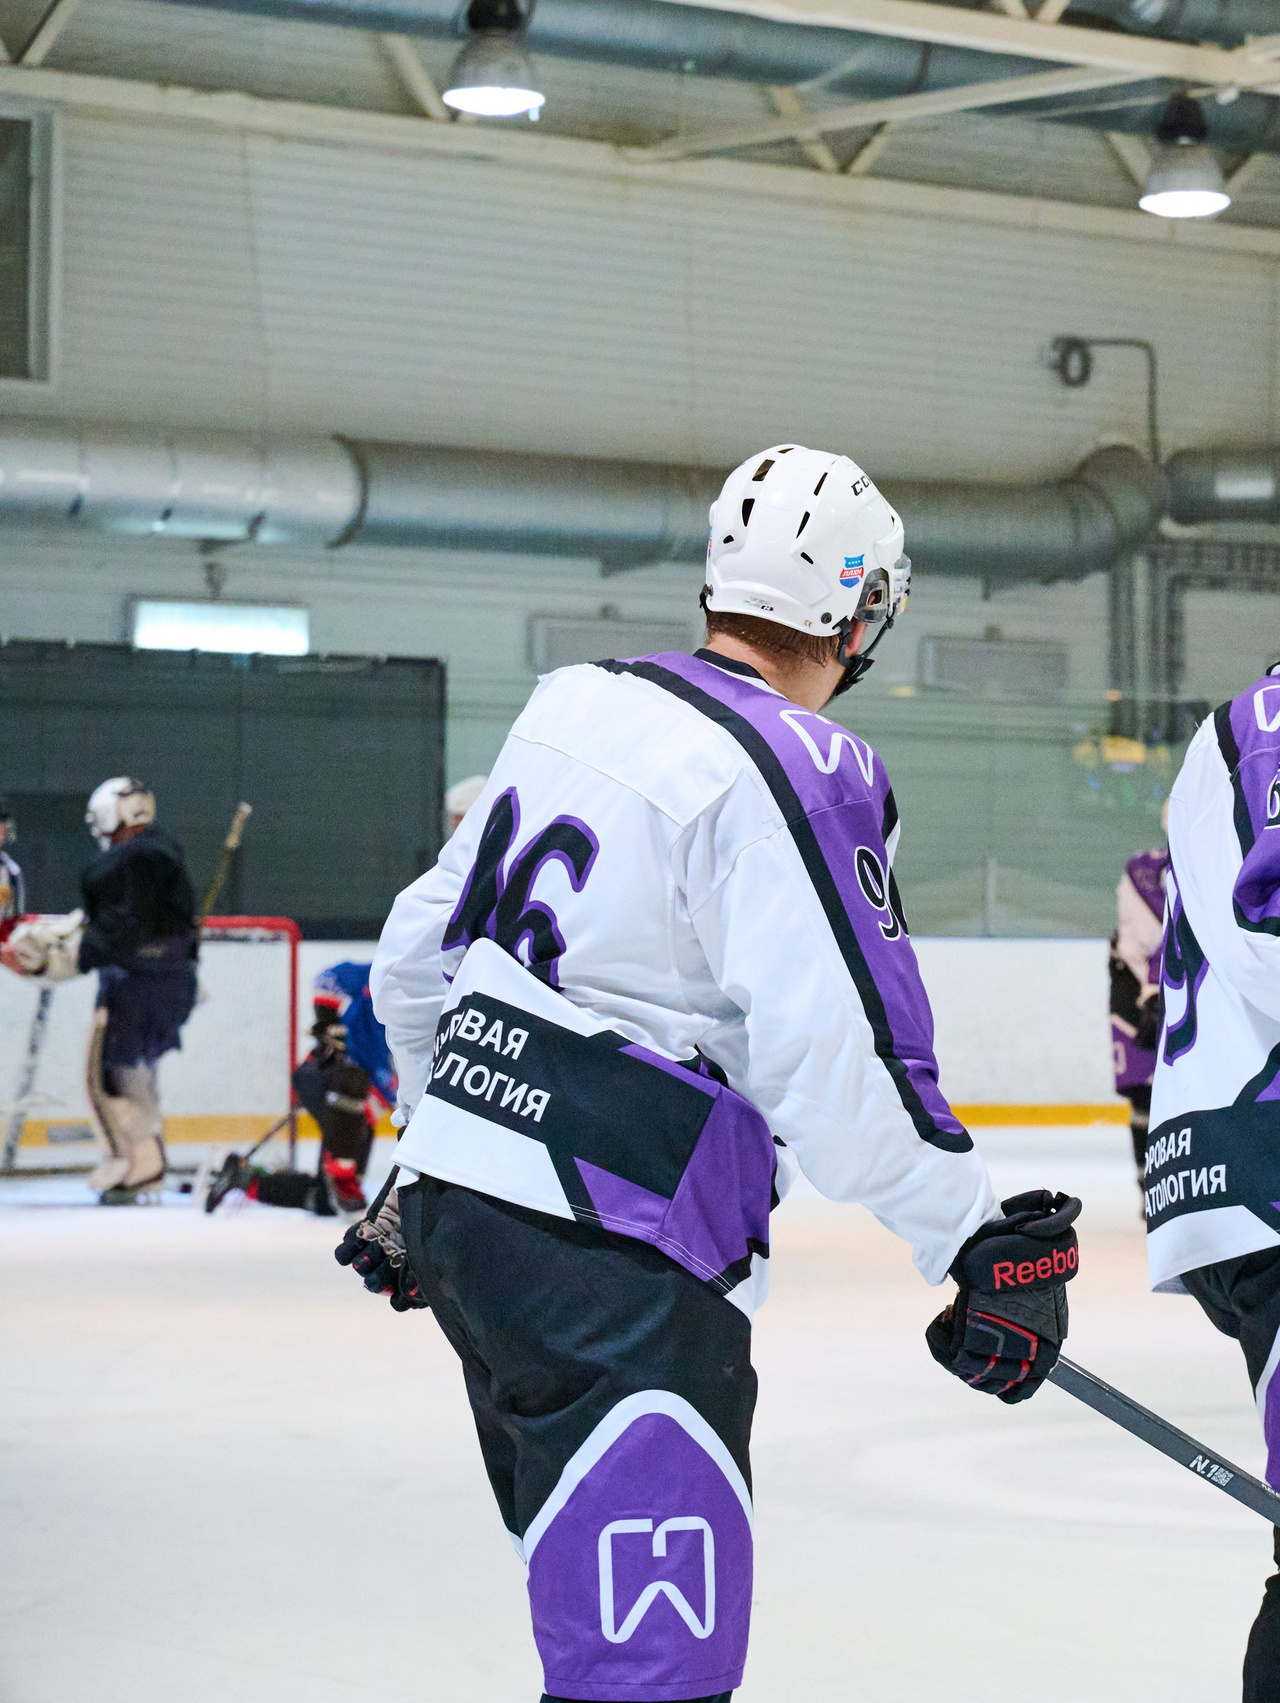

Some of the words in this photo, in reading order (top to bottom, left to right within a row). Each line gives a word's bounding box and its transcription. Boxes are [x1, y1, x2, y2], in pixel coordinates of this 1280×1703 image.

[851, 474, 871, 496] CC
[432, 1051, 551, 1123] ЛОГИЯ
[993, 1244, 1079, 1290] Reebo
